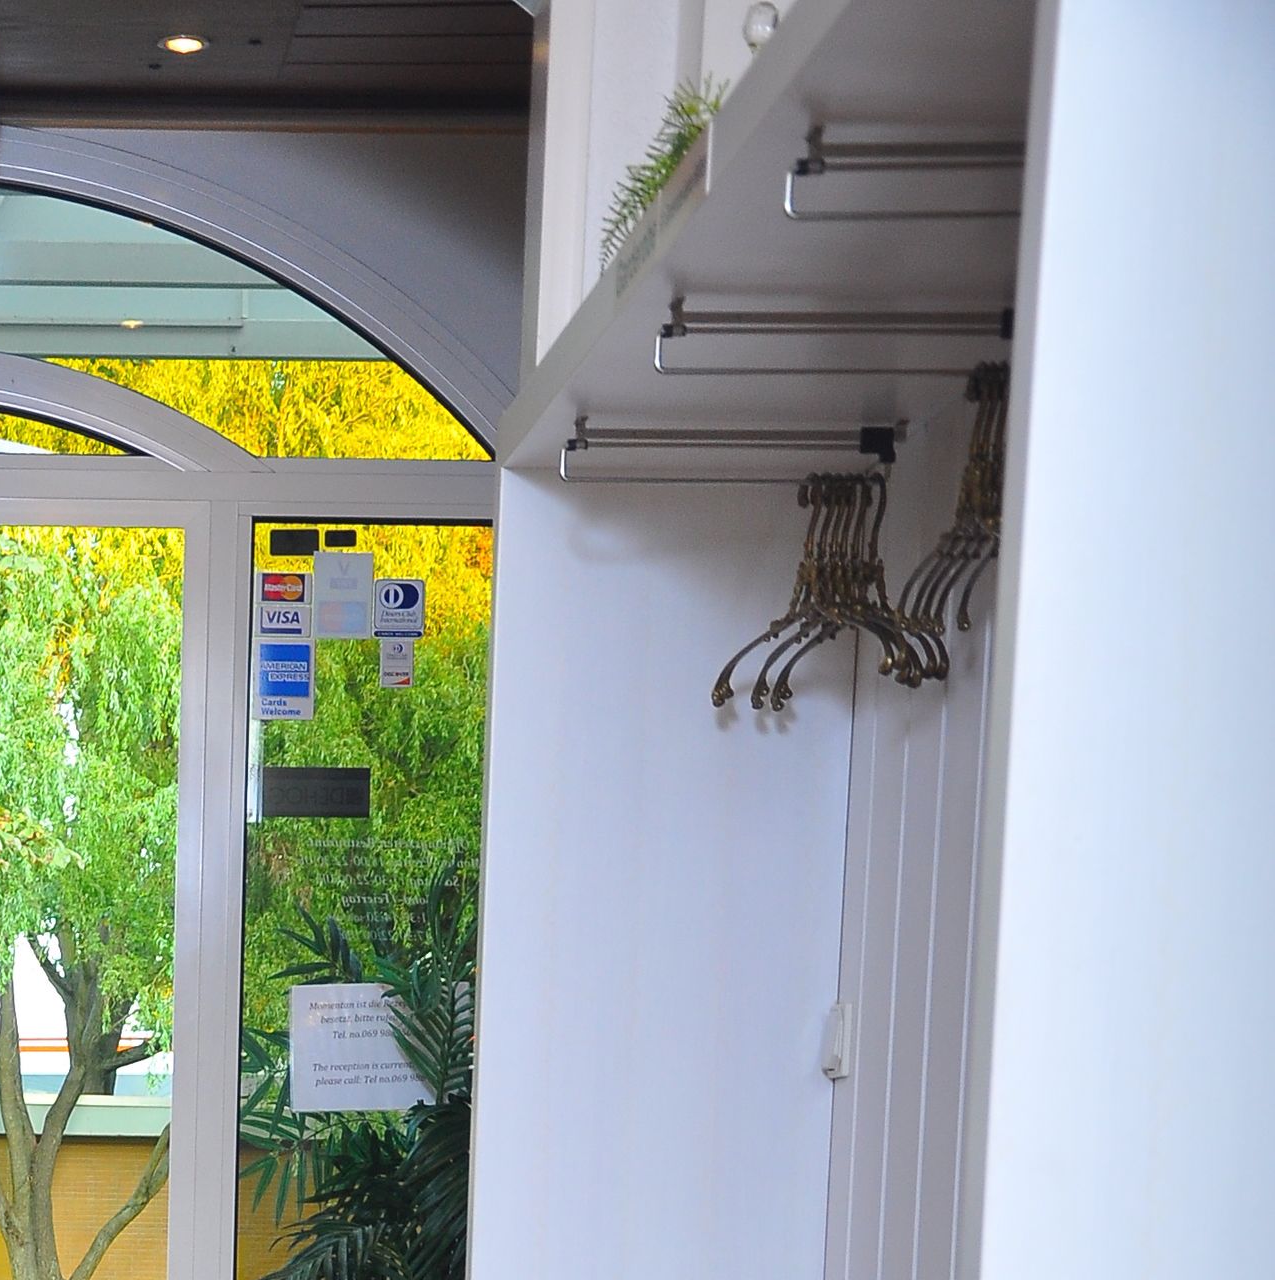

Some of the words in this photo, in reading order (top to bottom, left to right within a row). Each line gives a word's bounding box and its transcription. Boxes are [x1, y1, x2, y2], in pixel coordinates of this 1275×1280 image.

[265, 611, 300, 624] VISA
[261, 662, 306, 670] AMERICAN
[270, 672, 310, 680] EXPRESS
[261, 698, 287, 706] Cards
[261, 707, 302, 716] Welcome
[309, 1001, 355, 1010] Momentan
[355, 1014, 374, 1022] bitte
[313, 1063, 328, 1072] The
[330, 1063, 370, 1073] reception
[315, 1078, 341, 1088] please
